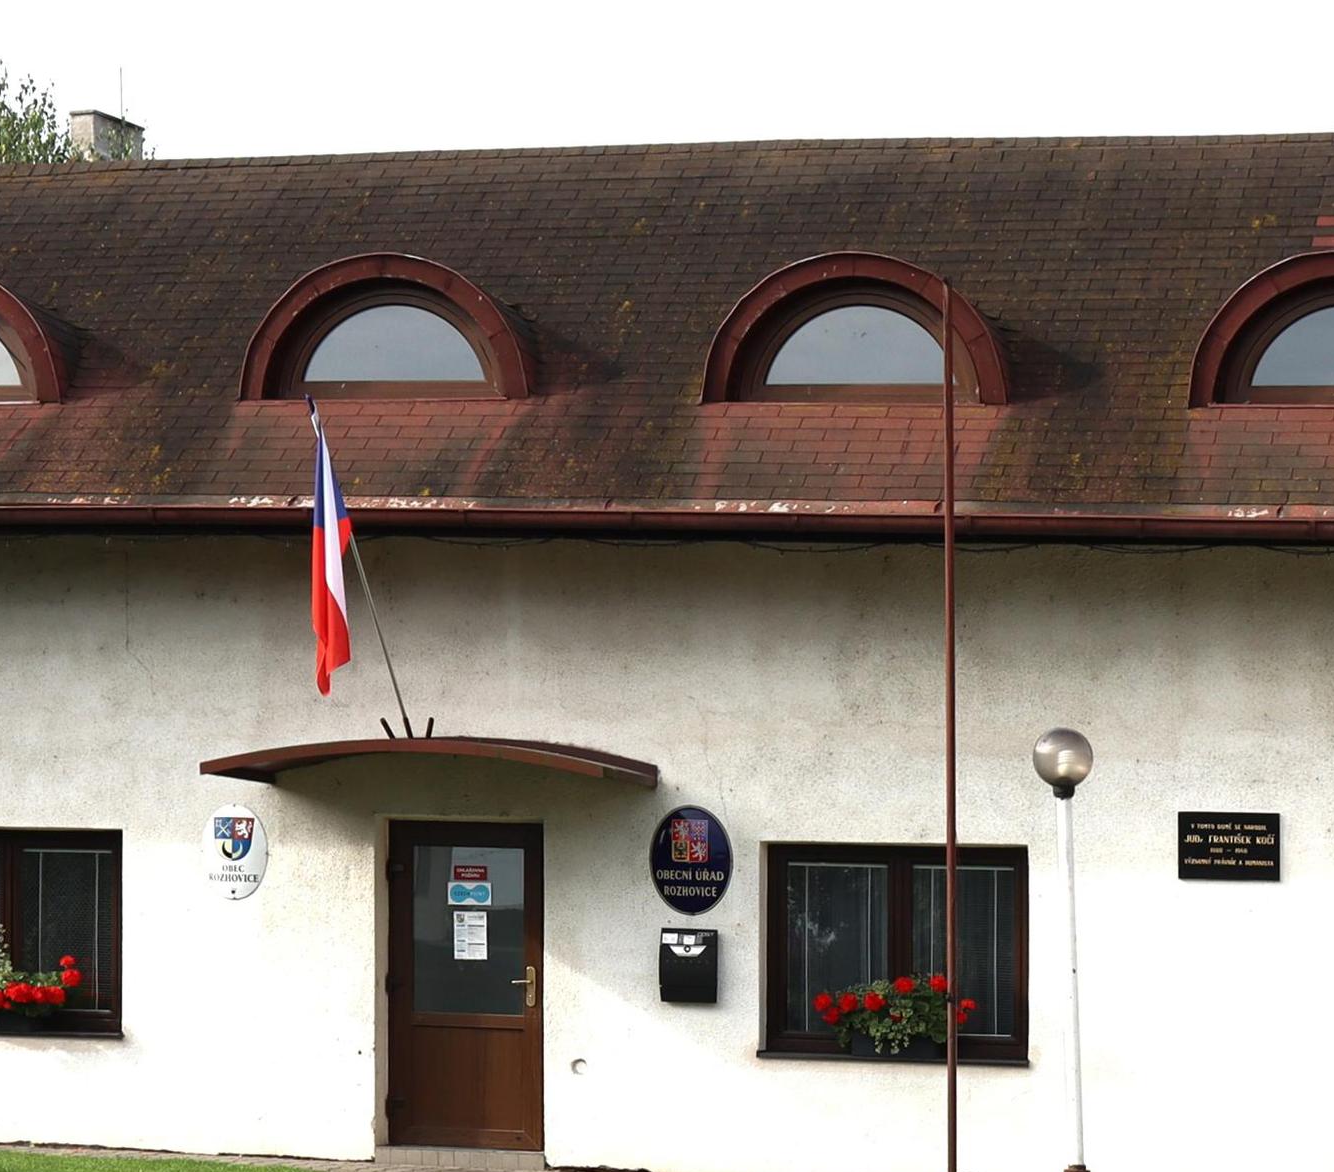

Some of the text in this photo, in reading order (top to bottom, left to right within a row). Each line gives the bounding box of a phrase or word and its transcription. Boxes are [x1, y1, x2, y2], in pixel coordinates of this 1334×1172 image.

[1208, 833, 1252, 845] FRANTIŠEK
[1255, 834, 1275, 845] KOČÍ
[222, 864, 245, 873] OBEC
[656, 867, 725, 881] OBECNÍ ÚŘAD
[208, 873, 259, 883] ROZHOVICE
[663, 885, 717, 897] ROZHOVICE
